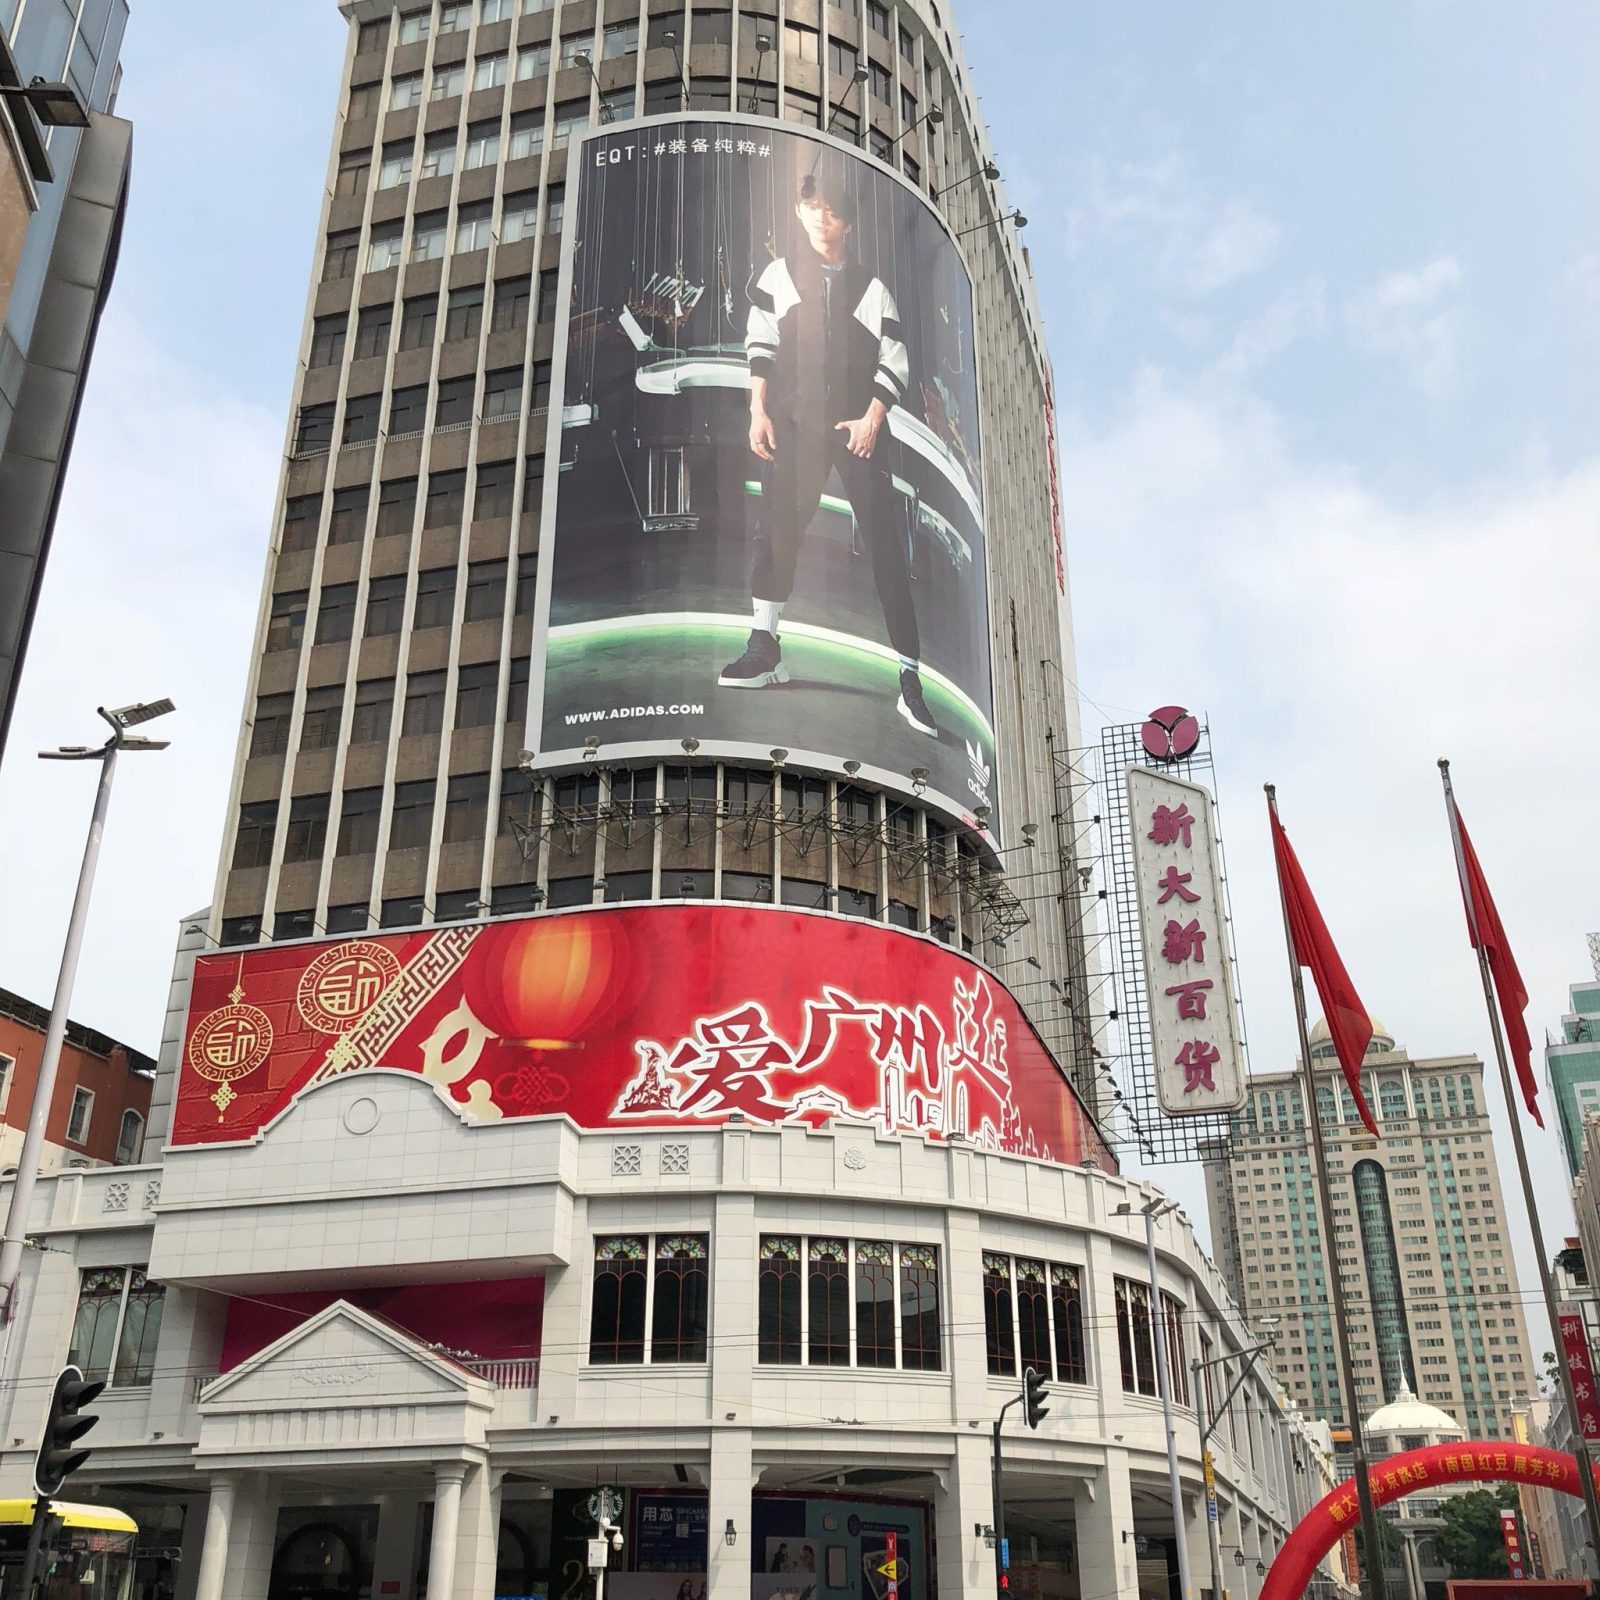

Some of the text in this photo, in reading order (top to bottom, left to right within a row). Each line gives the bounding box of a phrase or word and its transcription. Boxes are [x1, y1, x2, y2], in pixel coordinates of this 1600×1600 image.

[564, 703, 705, 727] WWW.ADIDAS.COM
[1147, 802, 1221, 1094] 新大新百货
[1561, 1321, 1598, 1434] 科技书店
